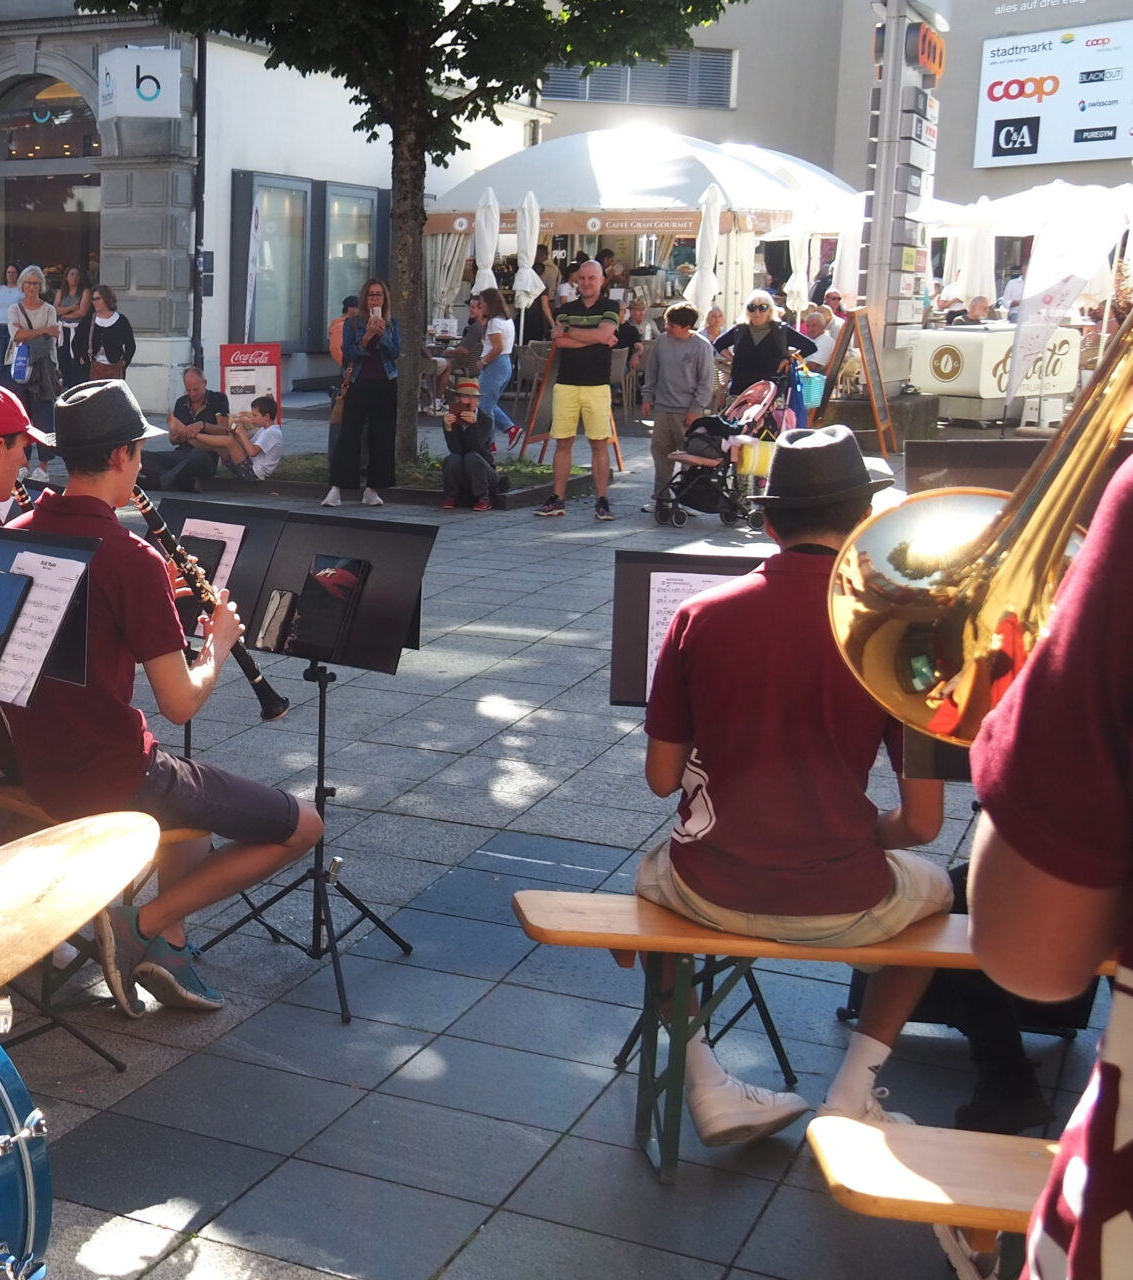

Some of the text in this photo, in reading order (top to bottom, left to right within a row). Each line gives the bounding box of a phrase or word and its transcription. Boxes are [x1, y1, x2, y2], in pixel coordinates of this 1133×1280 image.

[994, 4, 1018, 15] alles
[990, 40, 1053, 58] stadtmarkt
[1085, 37, 1111, 48] coop
[136, 65, 160, 101] b
[987, 75, 1060, 103] coop
[1088, 99, 1119, 108] swisscom
[998, 125, 1033, 149] C&A
